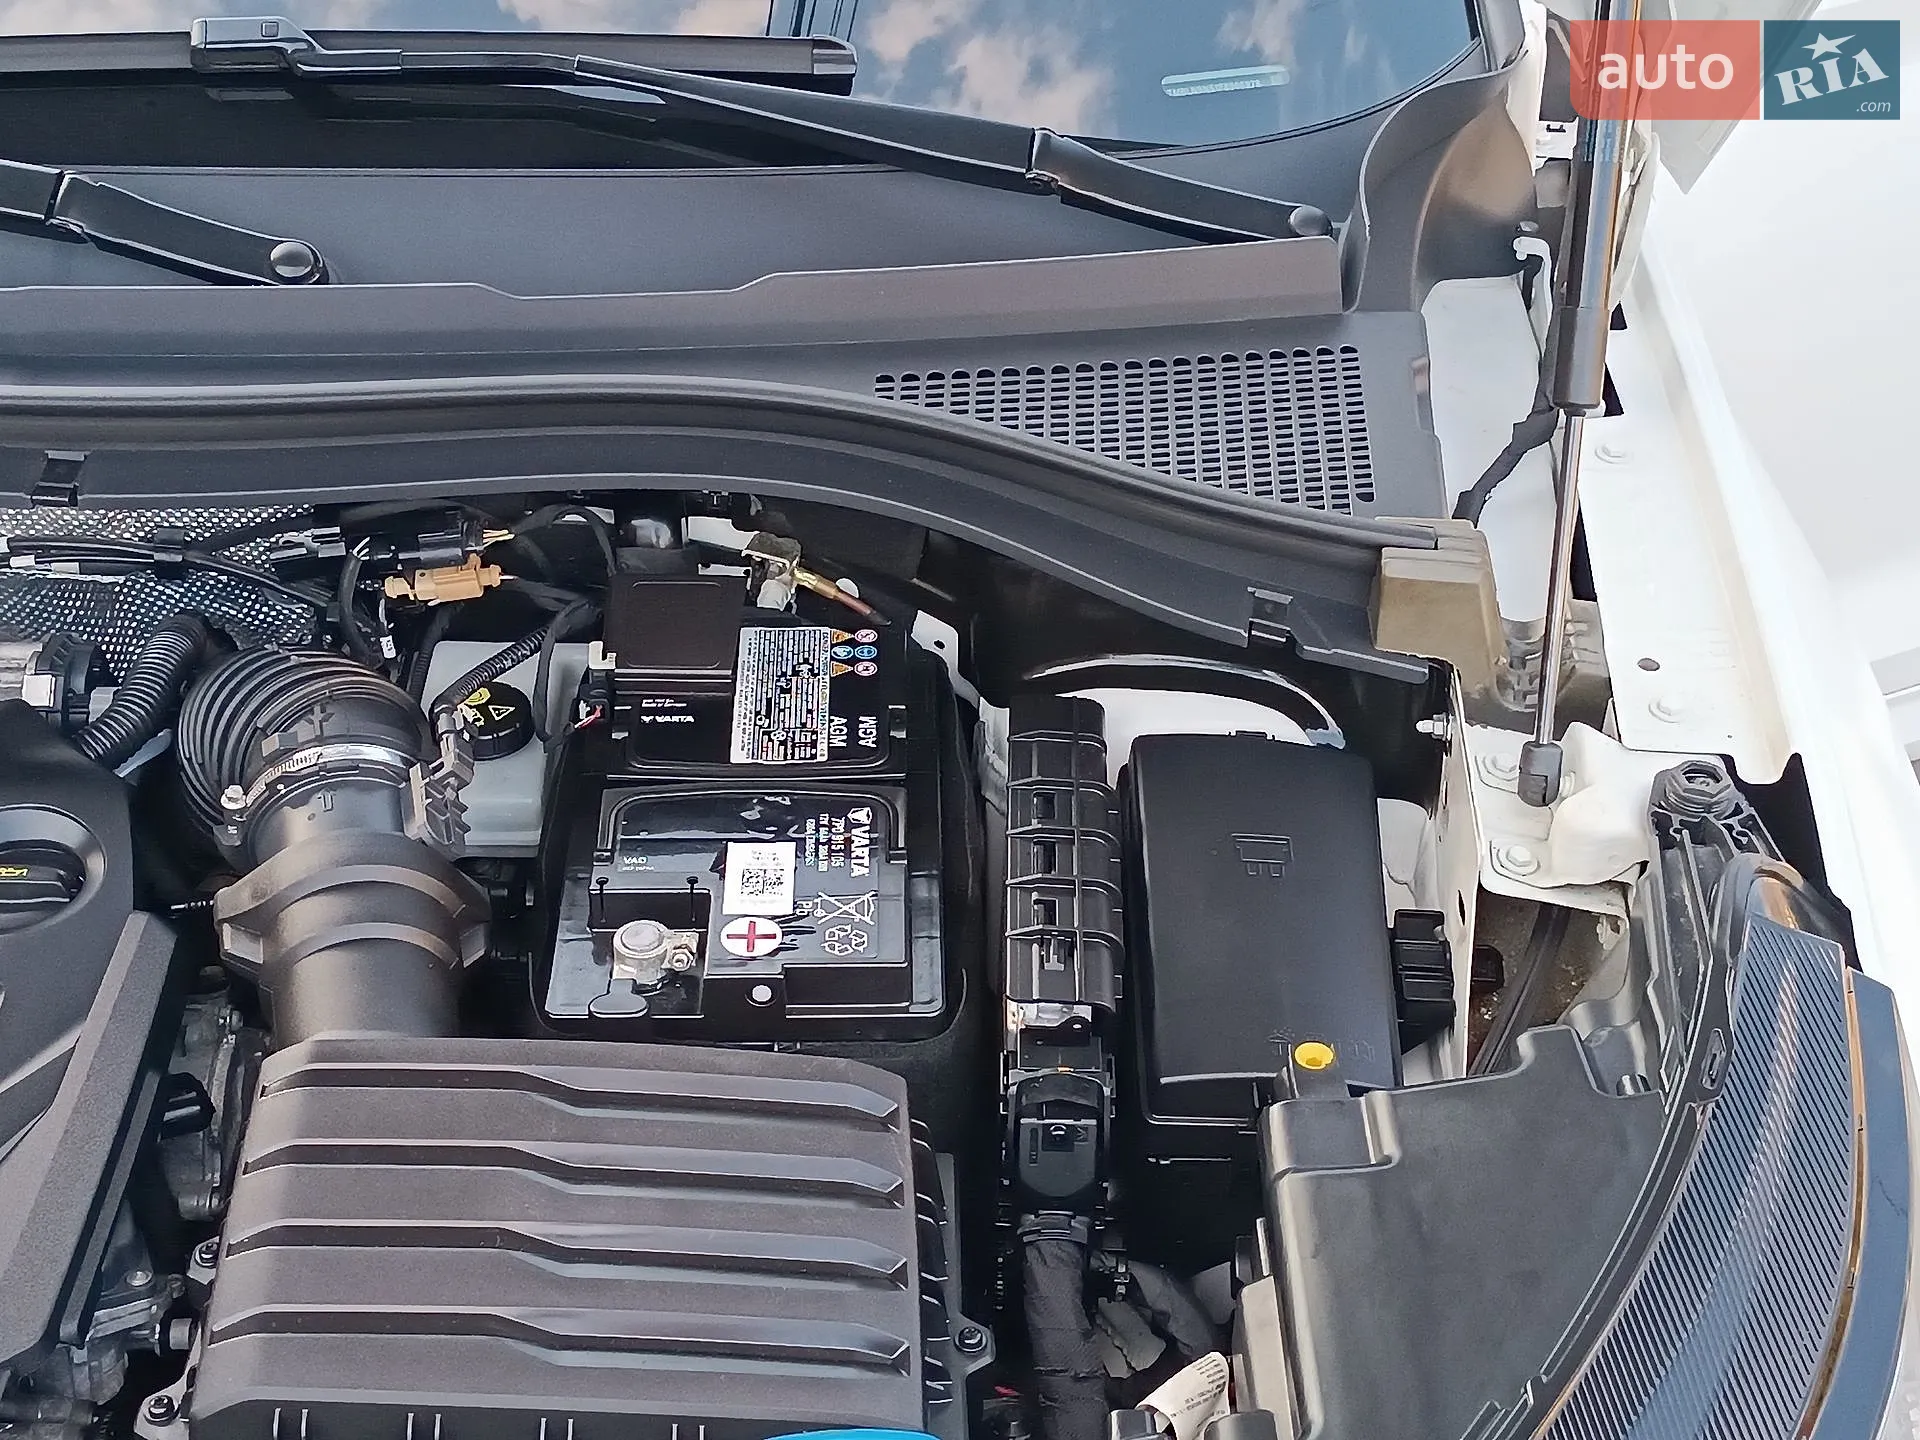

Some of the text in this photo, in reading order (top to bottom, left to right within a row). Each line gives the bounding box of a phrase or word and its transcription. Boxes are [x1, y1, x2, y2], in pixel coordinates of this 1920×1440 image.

[655, 715, 695, 723] VARTA
[829, 715, 848, 748] AGM
[858, 715, 877, 748] AGM
[830, 834, 845, 851] 915
[830, 852, 845, 868] 105
[850, 826, 871, 877] VARTA
[796, 901, 814, 915] Pb
